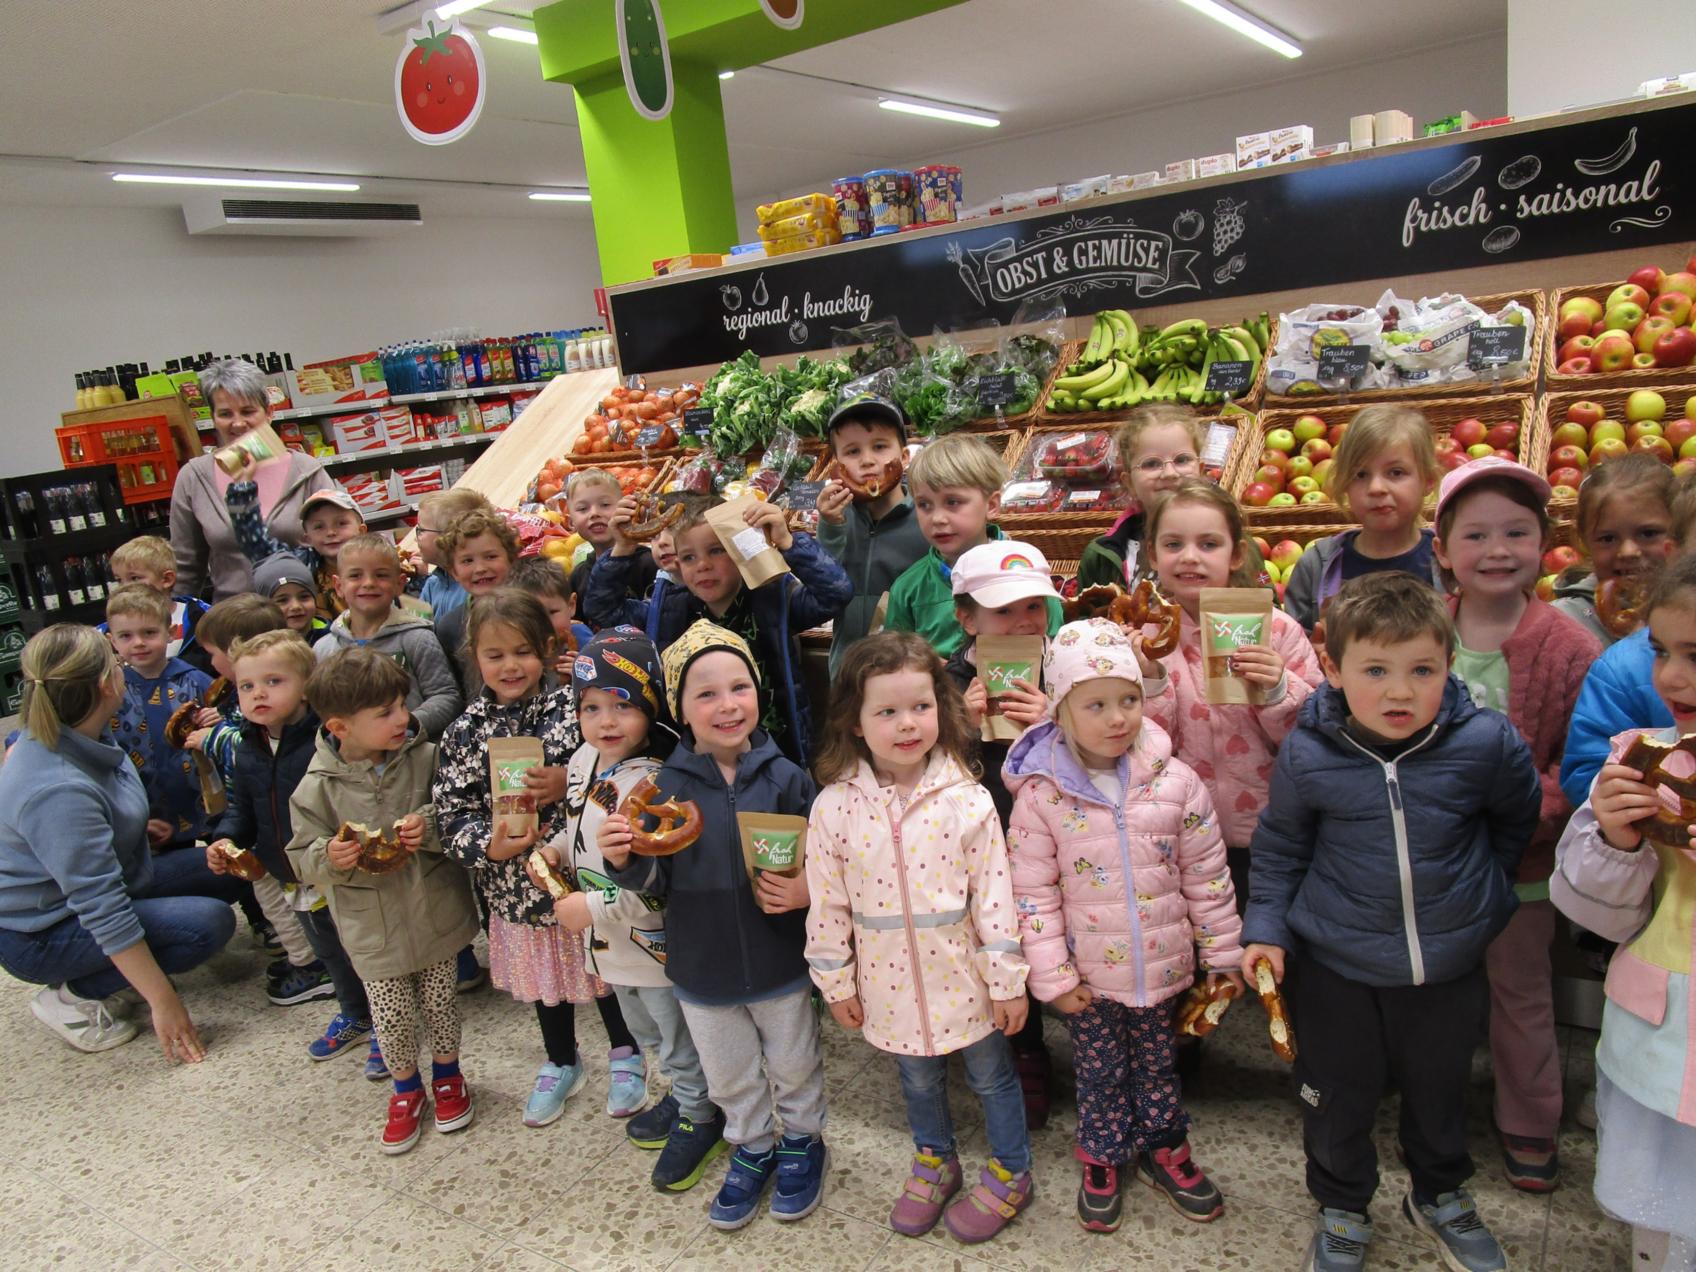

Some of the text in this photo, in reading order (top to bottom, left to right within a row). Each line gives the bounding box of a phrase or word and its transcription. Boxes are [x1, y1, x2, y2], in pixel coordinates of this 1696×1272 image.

[1402, 159, 1662, 248] frisch saisonal
[996, 233, 1163, 293] OBST & GEMÜSE
[722, 284, 874, 341] regional knackig
[1433, 328, 1466, 348] GRAPE
[1472, 329, 1510, 339] Trauben
[1321, 348, 1355, 357] Trauben
[772, 854, 794, 865] Natur
